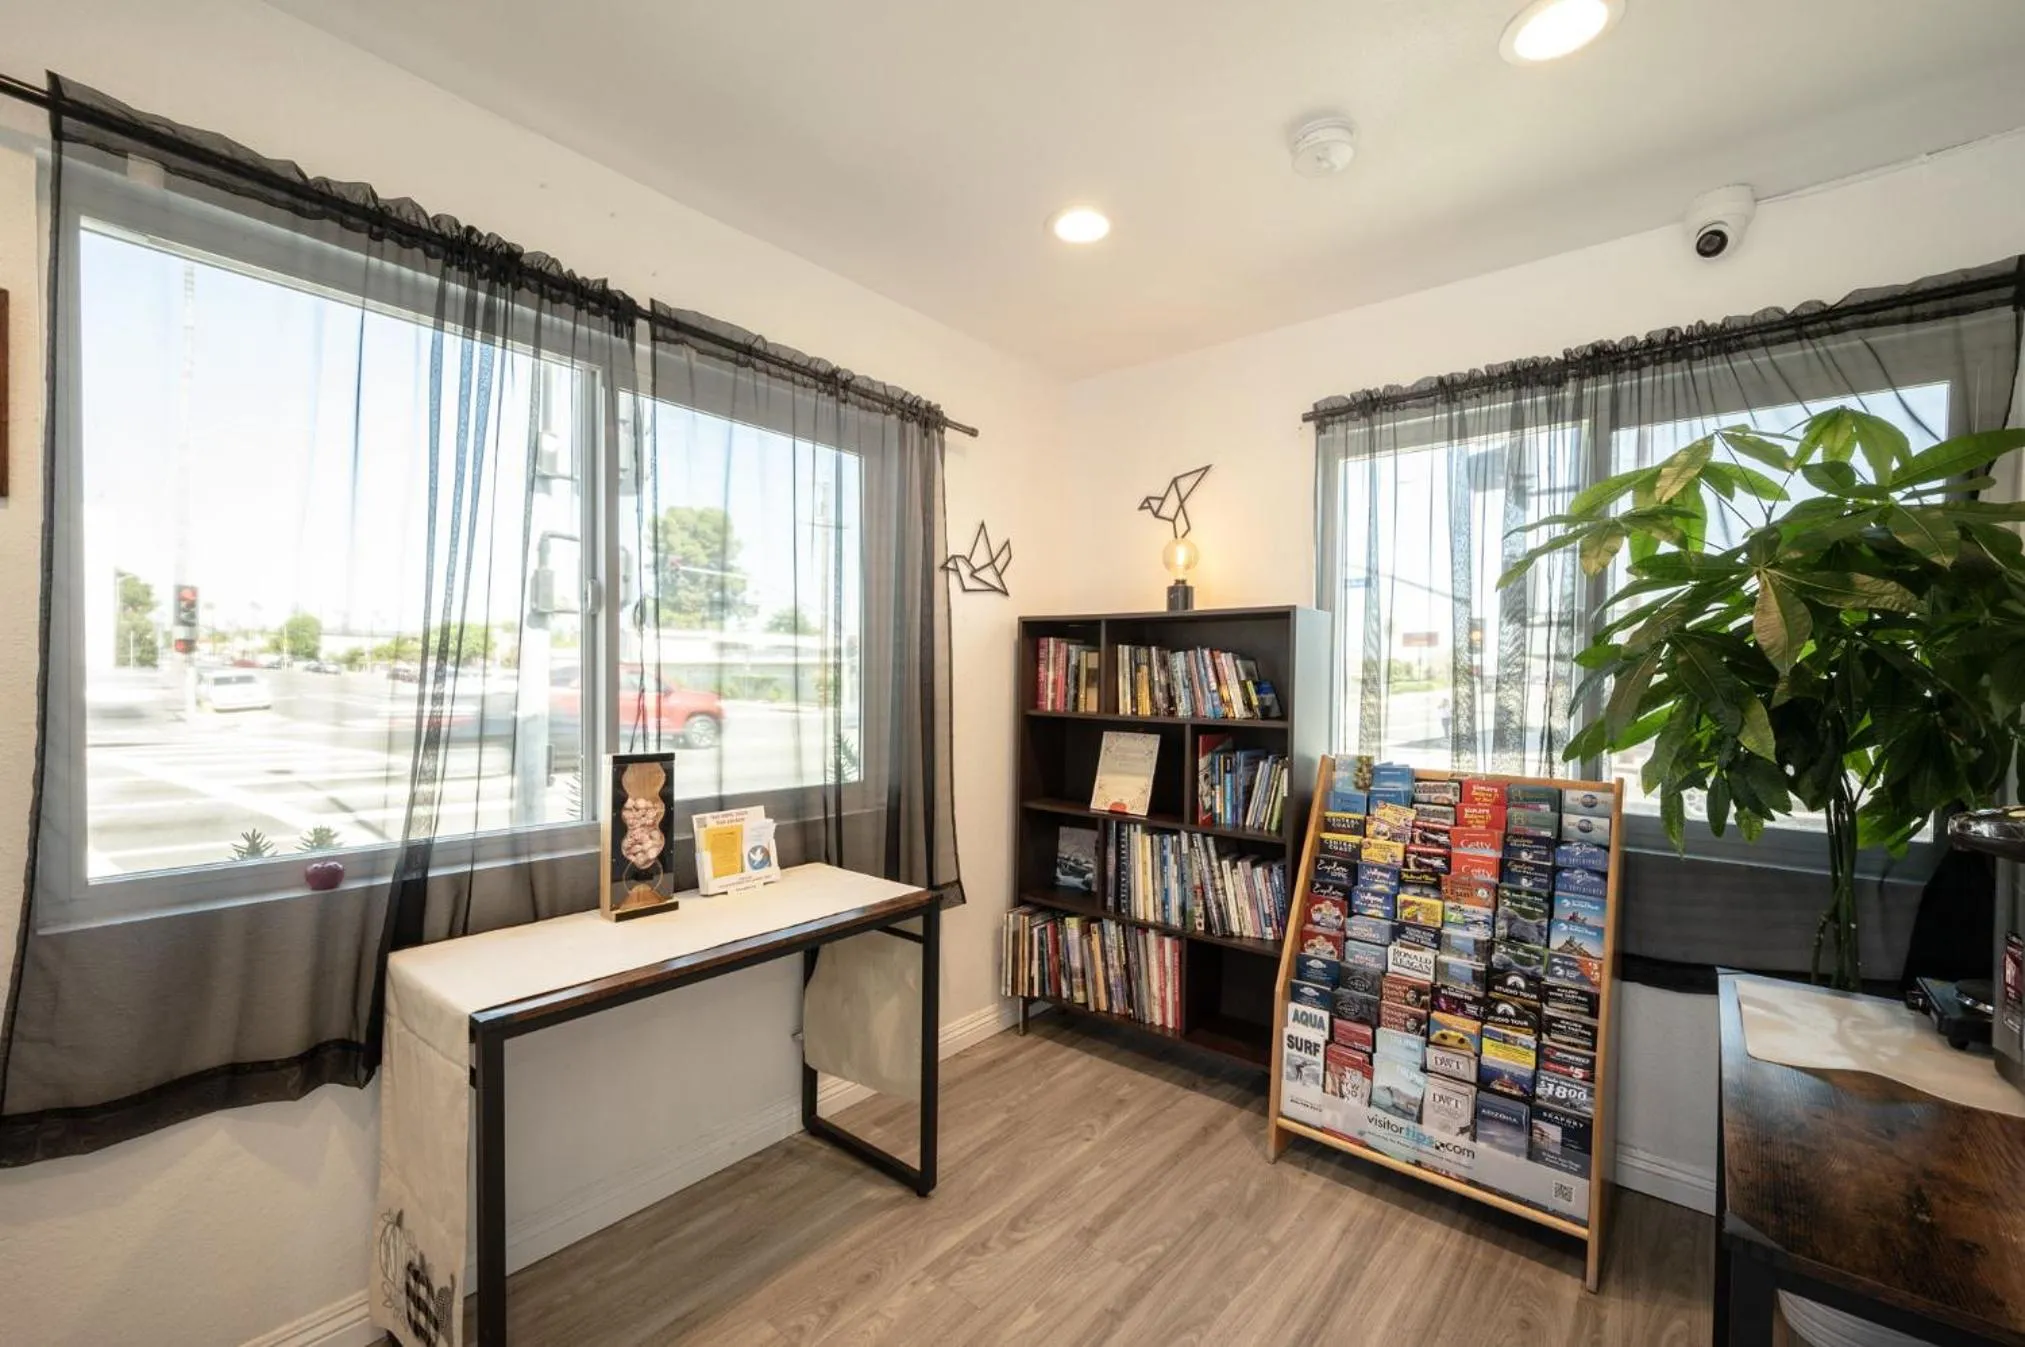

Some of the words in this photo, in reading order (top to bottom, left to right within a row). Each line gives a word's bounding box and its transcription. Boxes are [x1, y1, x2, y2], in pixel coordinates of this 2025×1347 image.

[1327, 817, 1359, 825] CENTRAL
[1324, 838, 1356, 848] CENTRAL
[1329, 844, 1352, 852] COAST
[1460, 839, 1491, 849] Getty
[1461, 865, 1493, 878] Getty
[1393, 947, 1432, 965] RONALD
[1392, 956, 1431, 973] REAGAN
[1494, 985, 1518, 996] STUDIO
[1519, 990, 1537, 999] TOUR
[1292, 1008, 1326, 1031] AQUA
[1487, 1015, 1509, 1024] STUDIO
[1510, 1018, 1529, 1026] TOUR
[1286, 1034, 1321, 1057] SURF
